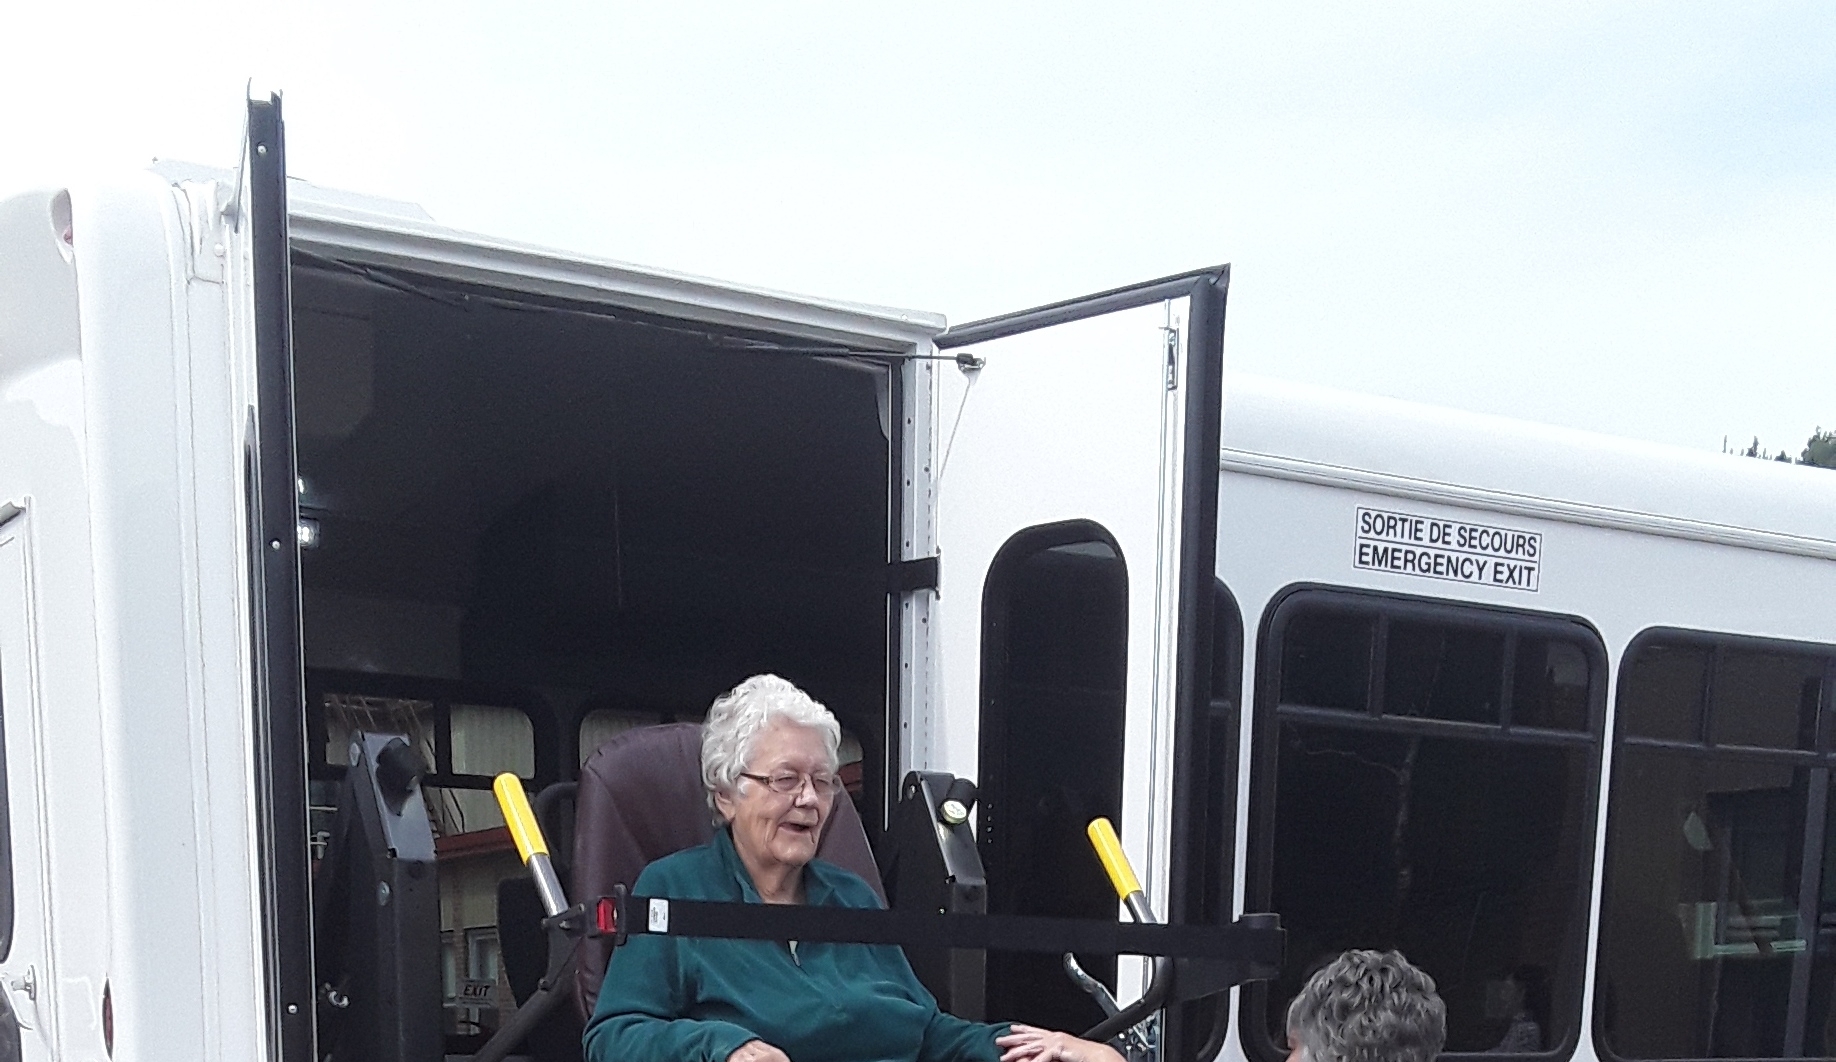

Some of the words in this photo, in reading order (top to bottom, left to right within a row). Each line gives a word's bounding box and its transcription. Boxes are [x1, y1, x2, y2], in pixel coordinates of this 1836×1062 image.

[1360, 511, 1424, 542] SORTIE
[1429, 521, 1452, 546] DE
[1456, 525, 1537, 558] SECOURS
[1357, 543, 1488, 581] EMERGENCY
[1492, 562, 1536, 588] EXIT
